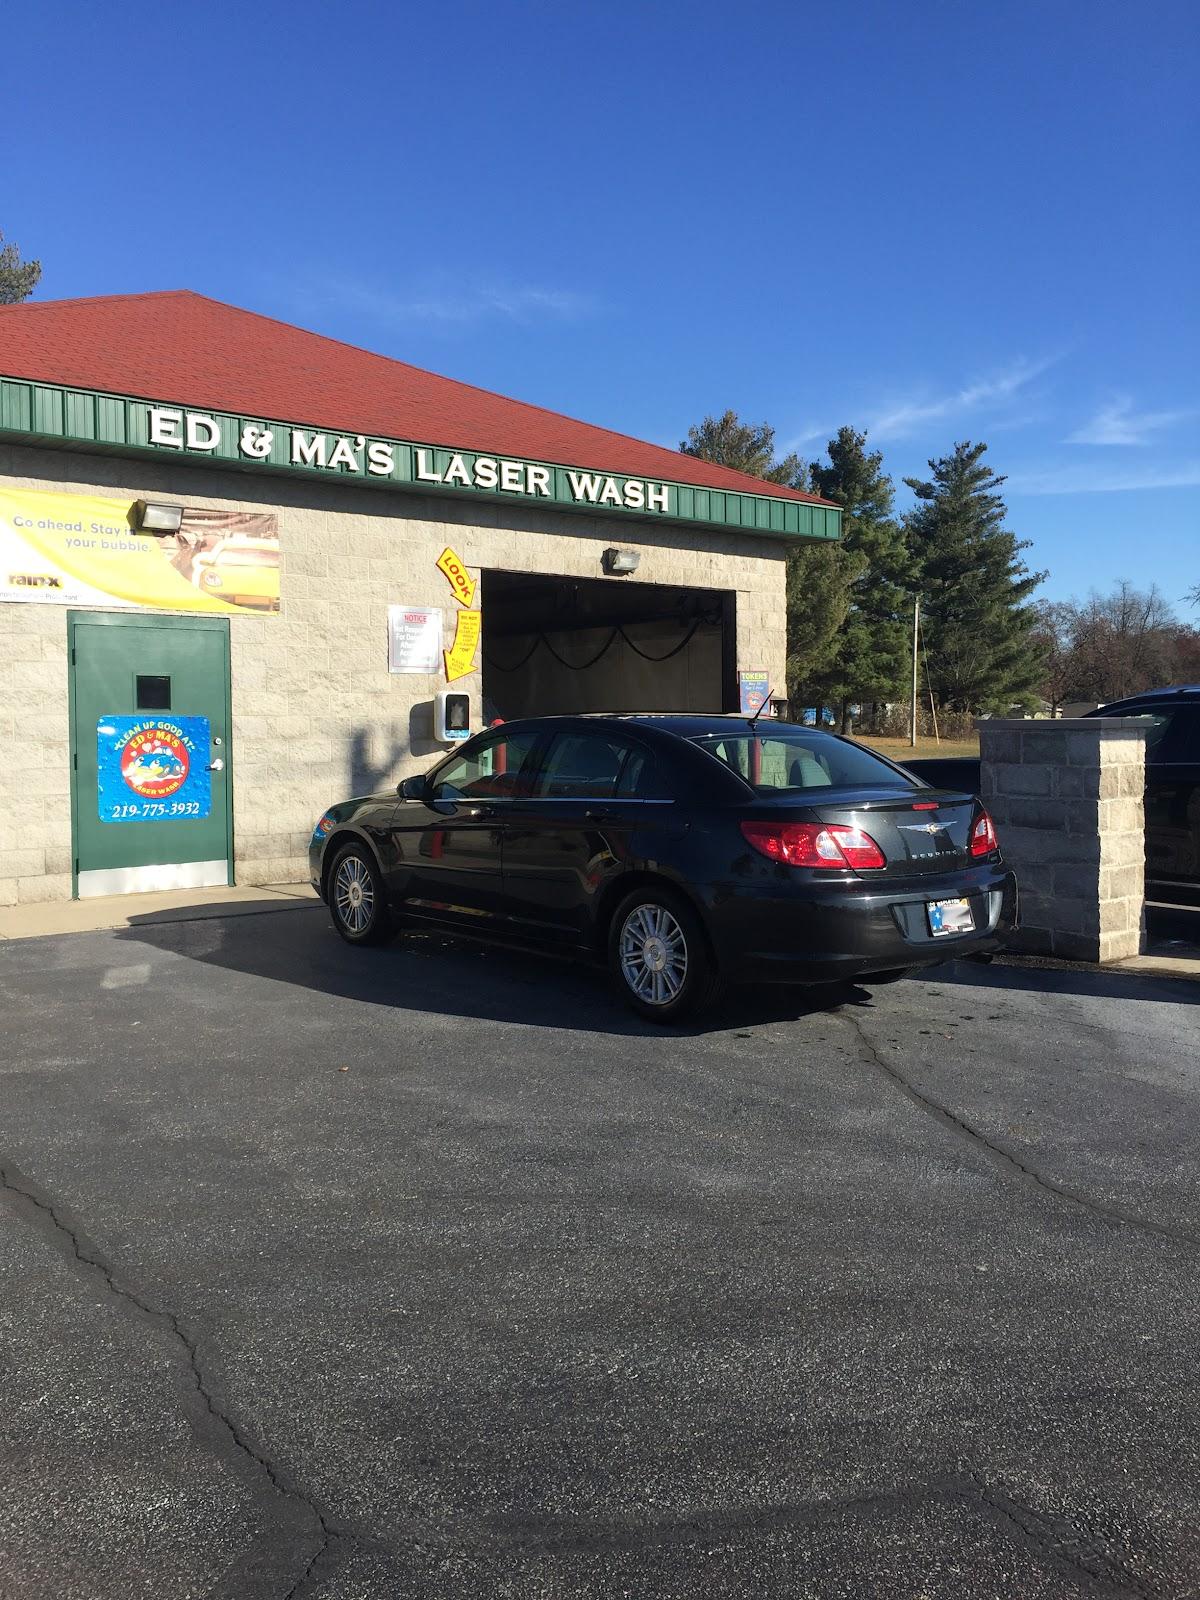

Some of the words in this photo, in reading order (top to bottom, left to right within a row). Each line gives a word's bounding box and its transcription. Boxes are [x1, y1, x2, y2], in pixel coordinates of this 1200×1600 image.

[149, 408, 220, 450] ED
[241, 426, 273, 458] &
[291, 430, 395, 475] MA'S
[416, 449, 551, 496] LASER
[568, 471, 669, 512] WASH
[13, 515, 33, 528] Go
[37, 519, 87, 533] ahead.
[90, 522, 120, 536] Stay
[65, 538, 97, 549] your
[101, 538, 153, 553] bubble.
[444, 556, 471, 598] LOOK
[404, 614, 428, 622] NOTICE
[741, 672, 768, 680] TOKENS
[142, 721, 155, 730] UP
[157, 721, 183, 738] GOOD
[129, 734, 145, 749] ED
[156, 730, 180, 749] MA'S
[158, 781, 180, 796] WASH
[111, 802, 201, 818] 219-775-3932
